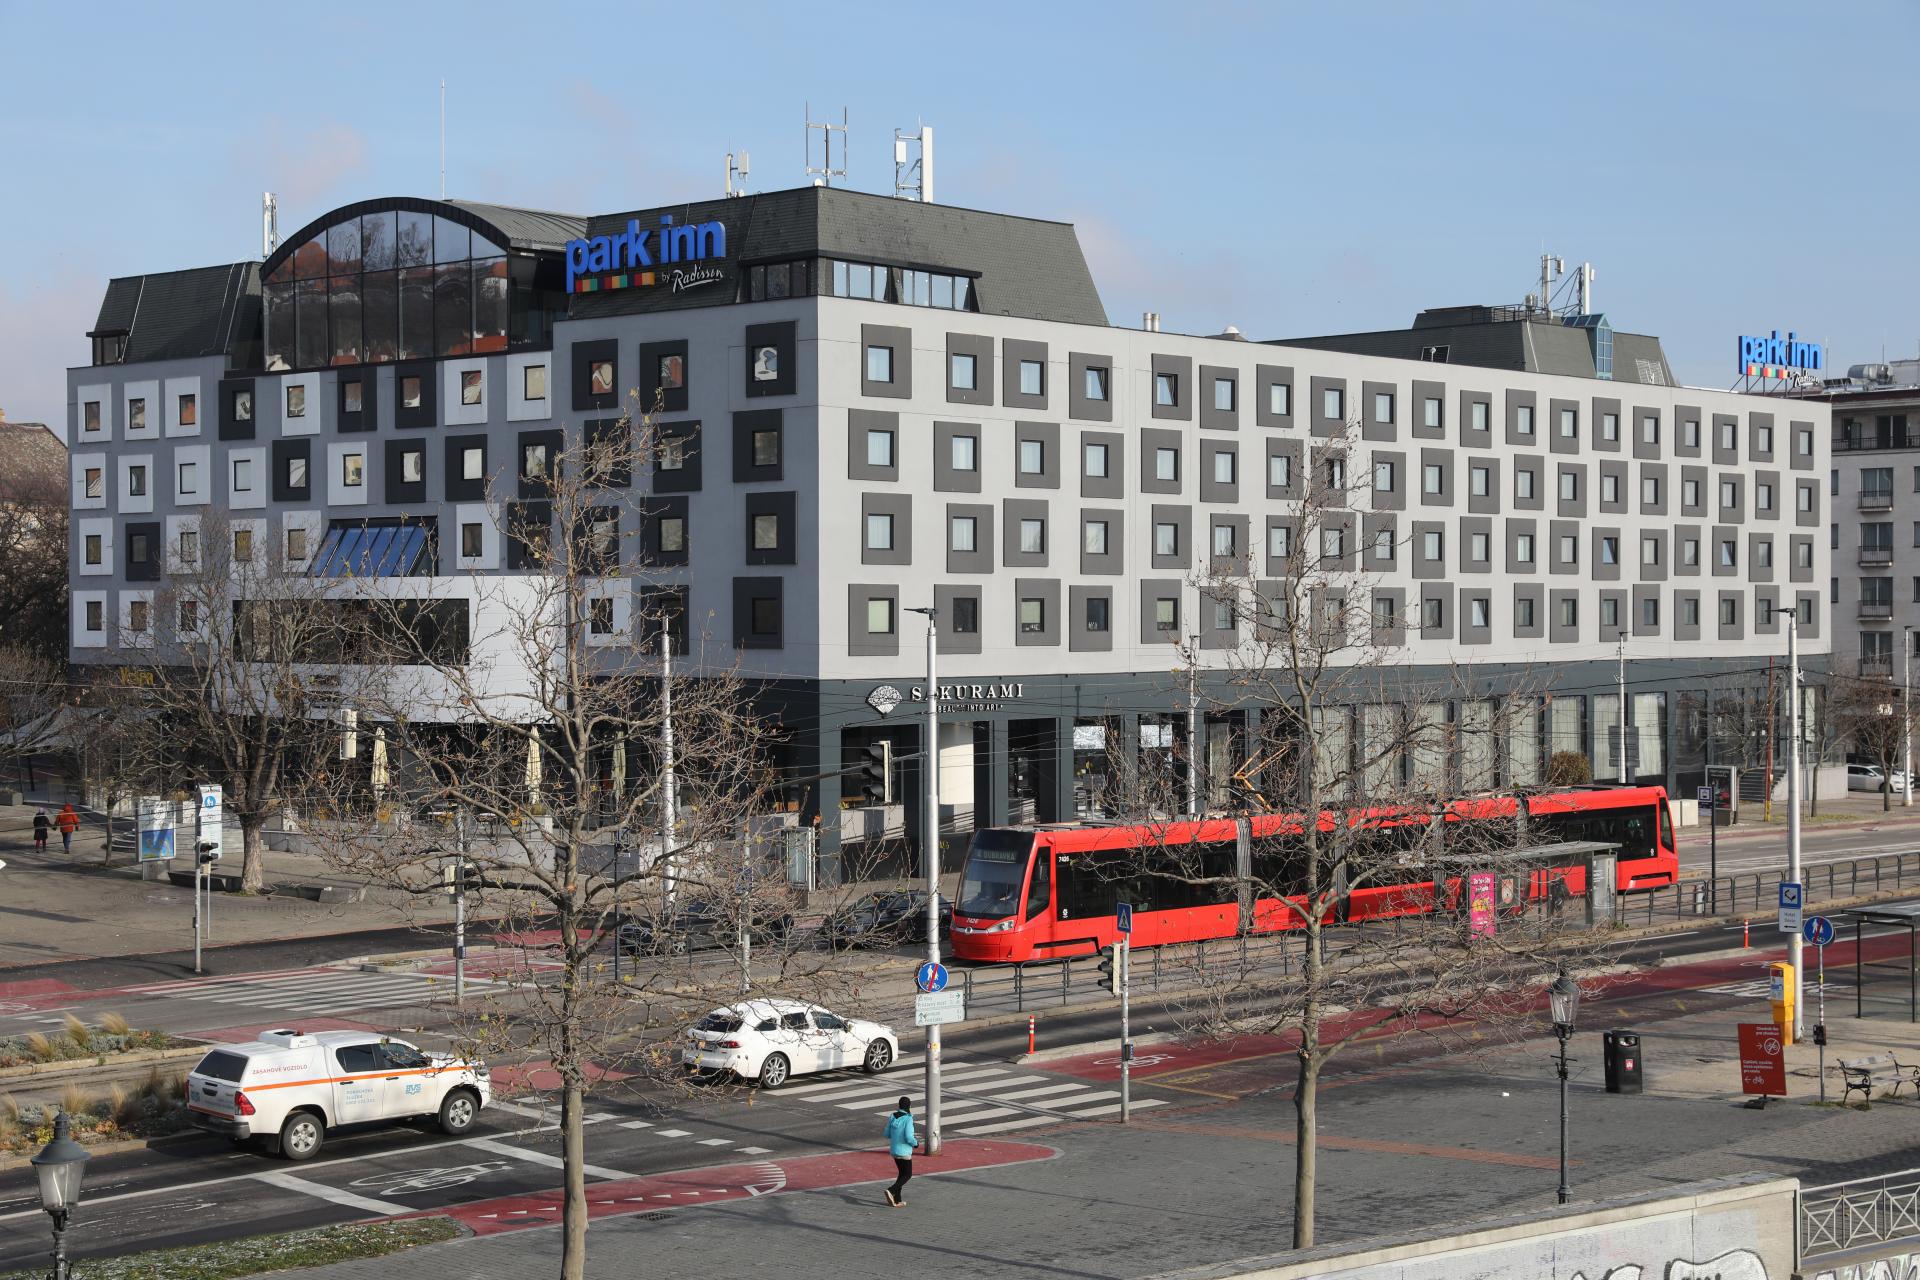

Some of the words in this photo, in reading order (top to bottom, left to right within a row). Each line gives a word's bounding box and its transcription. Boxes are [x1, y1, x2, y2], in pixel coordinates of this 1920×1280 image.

[566, 218, 653, 294] park
[660, 214, 727, 264] inn
[661, 271, 671, 284] by
[671, 264, 724, 294] Radisson
[1738, 329, 1788, 375] park
[1788, 331, 1822, 369] inn
[967, 703, 984, 712] INTO
